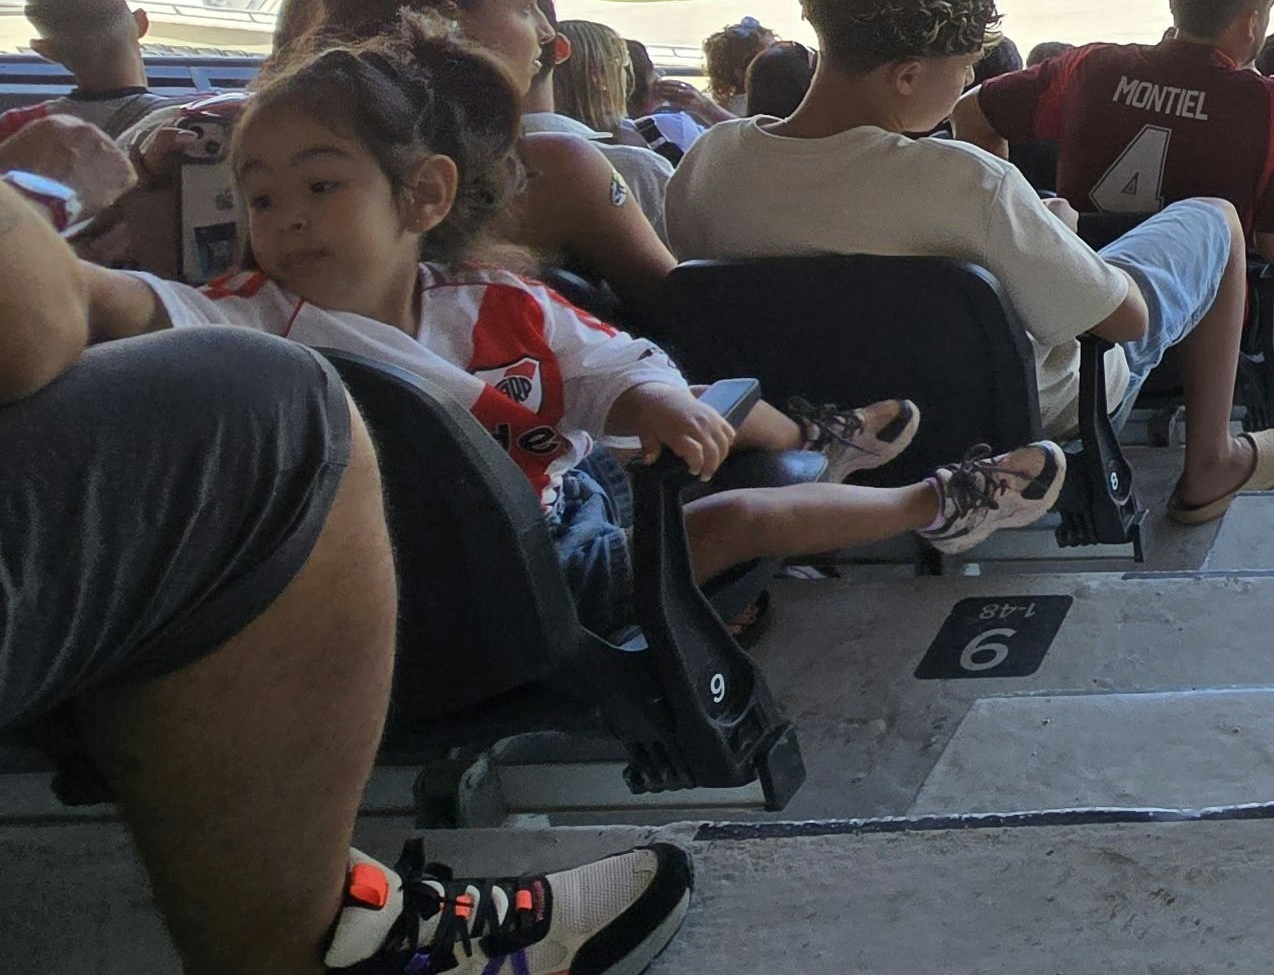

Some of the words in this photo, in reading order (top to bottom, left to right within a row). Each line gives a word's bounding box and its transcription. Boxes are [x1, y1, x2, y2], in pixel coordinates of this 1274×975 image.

[1112, 75, 1209, 121] MONTIEL
[1088, 123, 1173, 214] 4
[1110, 471, 1119, 491] 8
[978, 602, 1037, 621] 1-48
[710, 673, 725, 704] 9
